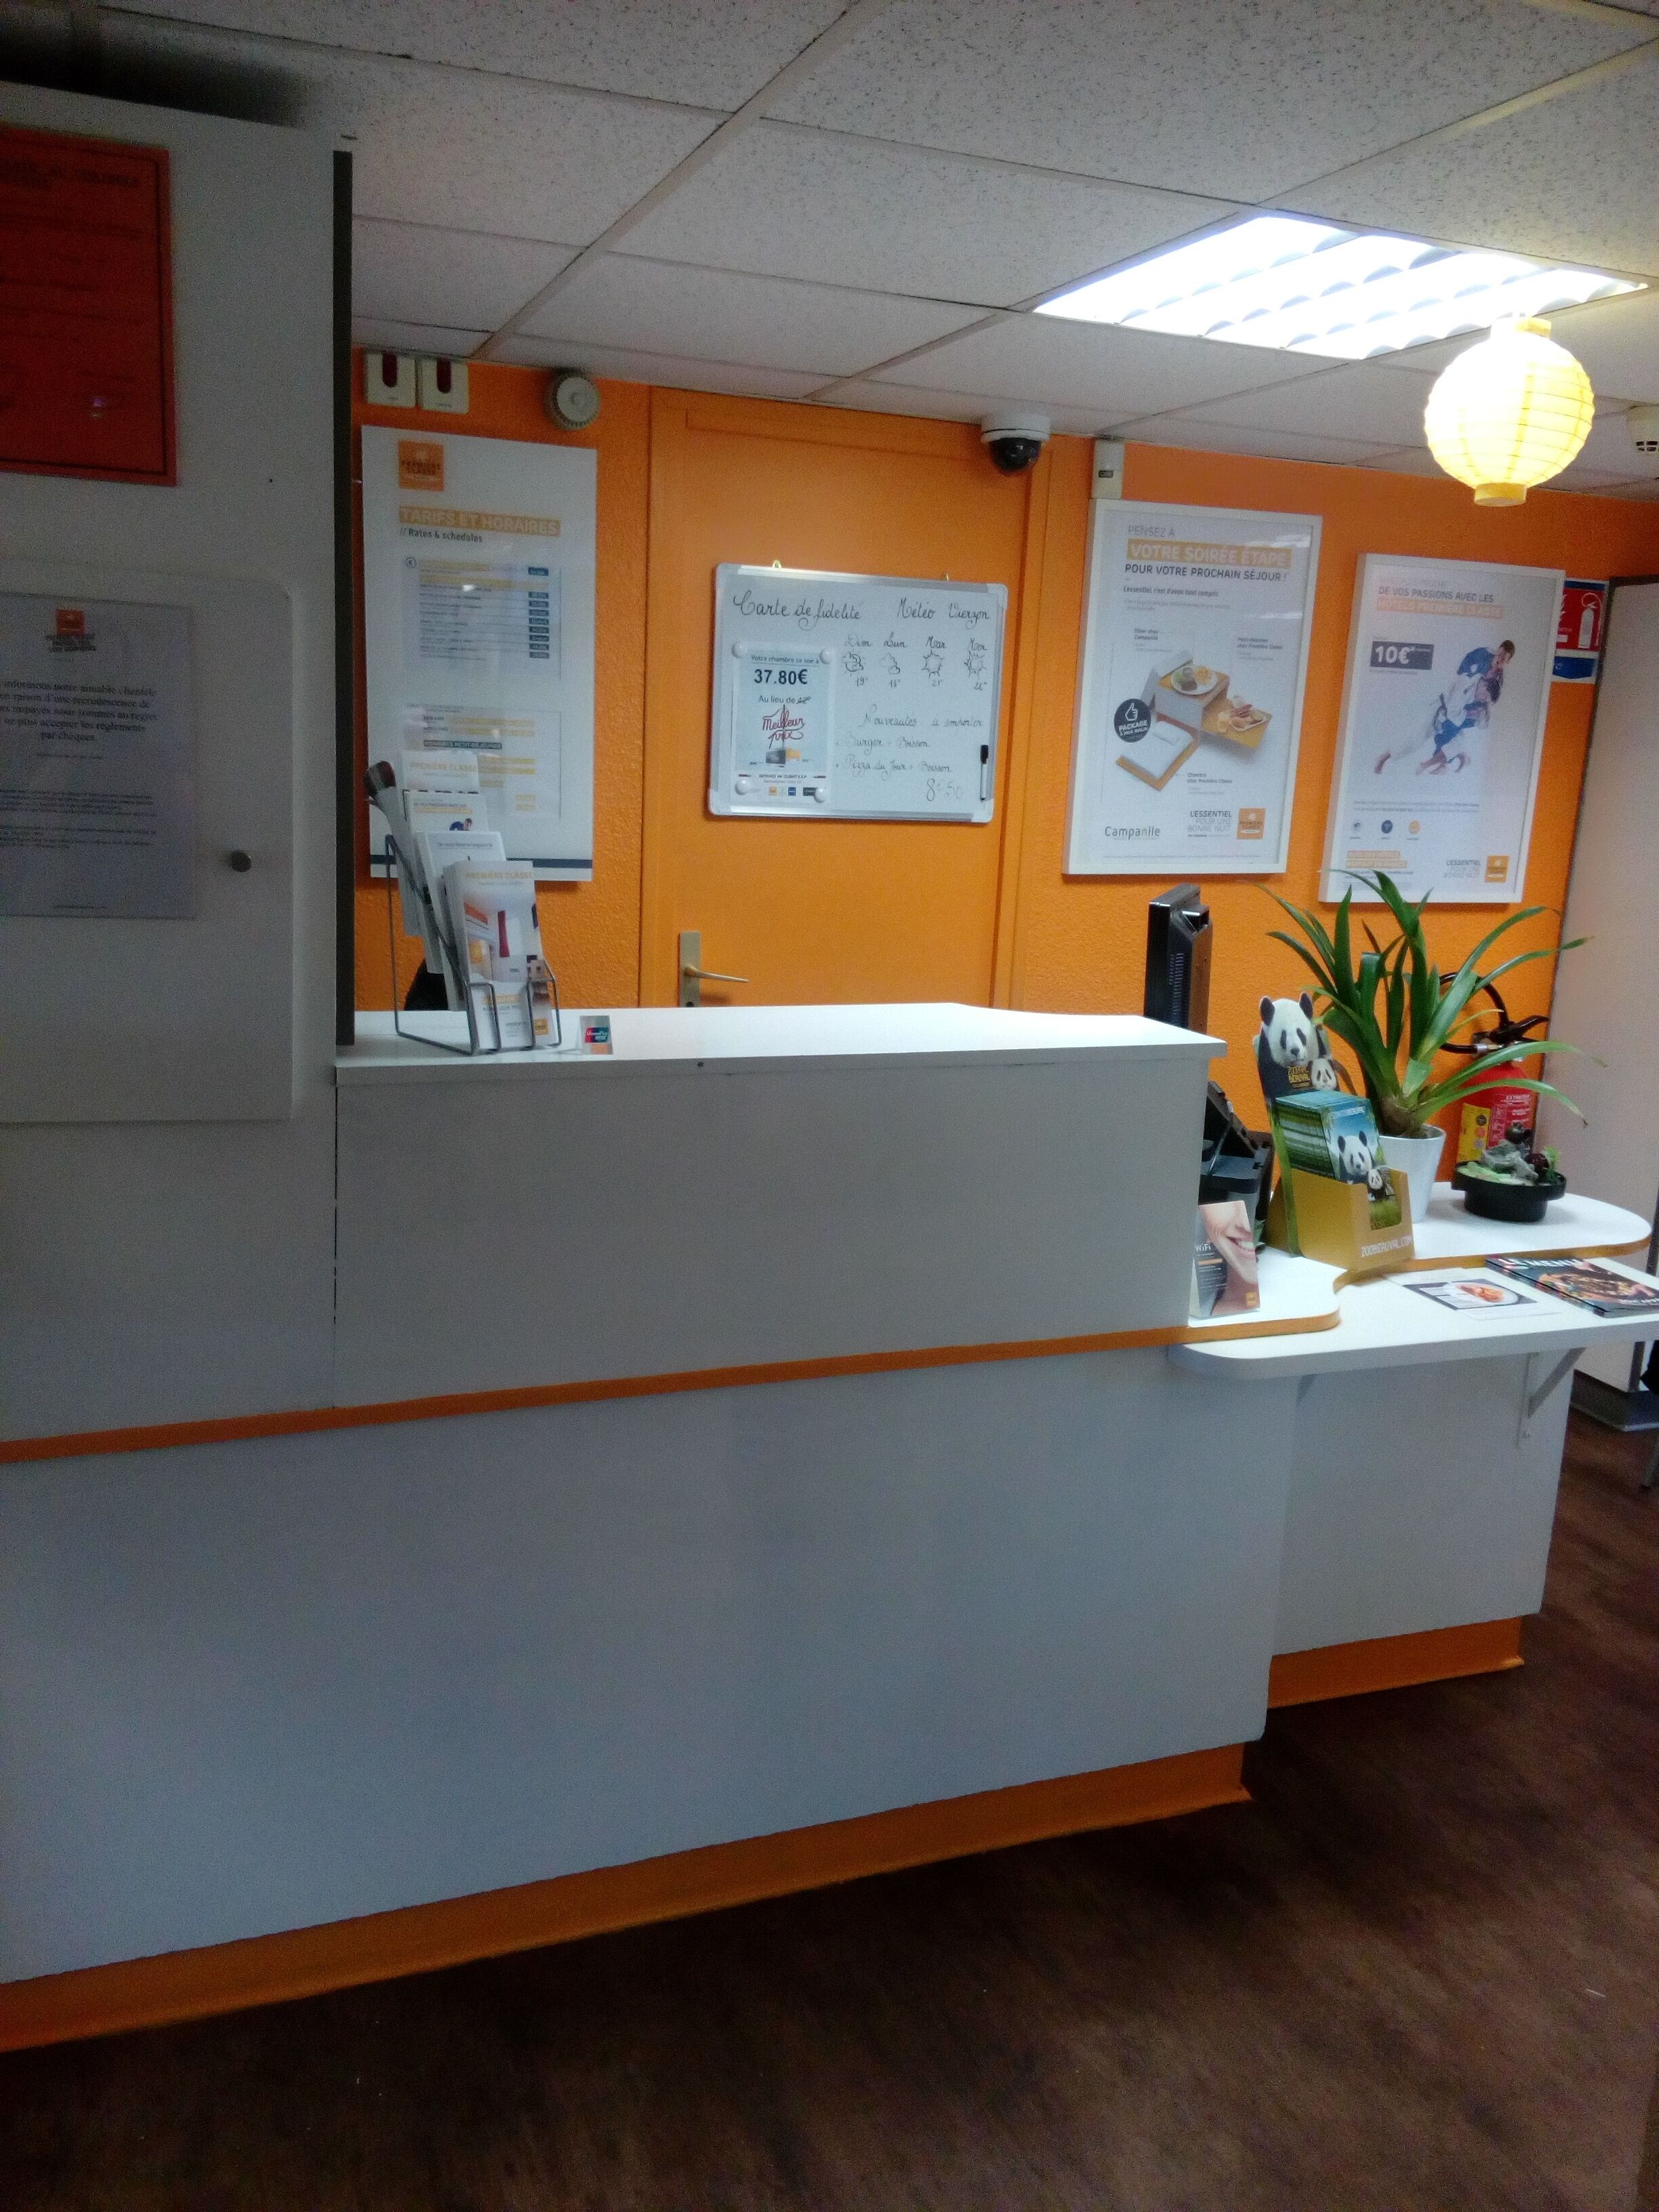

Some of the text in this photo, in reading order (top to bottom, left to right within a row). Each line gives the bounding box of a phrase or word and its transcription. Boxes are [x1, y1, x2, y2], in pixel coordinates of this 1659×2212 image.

[409, 529, 432, 538] Rates
[442, 532, 483, 543] schedules
[1128, 526, 1166, 537] PENSEZ
[1130, 543, 1287, 567] VOTRE SOIRÉE ÉTAPE
[1125, 563, 1153, 574] POUR
[1156, 565, 1187, 576] VOTRE
[1190, 567, 1241, 579] PROCHAIN
[1243, 568, 1282, 581] SÉJOUR
[1378, 586, 1494, 602] DE VOS PASSIONS AVEC LES
[733, 590, 791, 617] Carte
[794, 598, 812, 617] de
[754, 668, 808, 685] 37.80€
[758, 695, 769, 703] Au
[771, 695, 785, 703] lieu
[785, 696, 796, 704] de
[1105, 825, 1160, 840] Campanile
